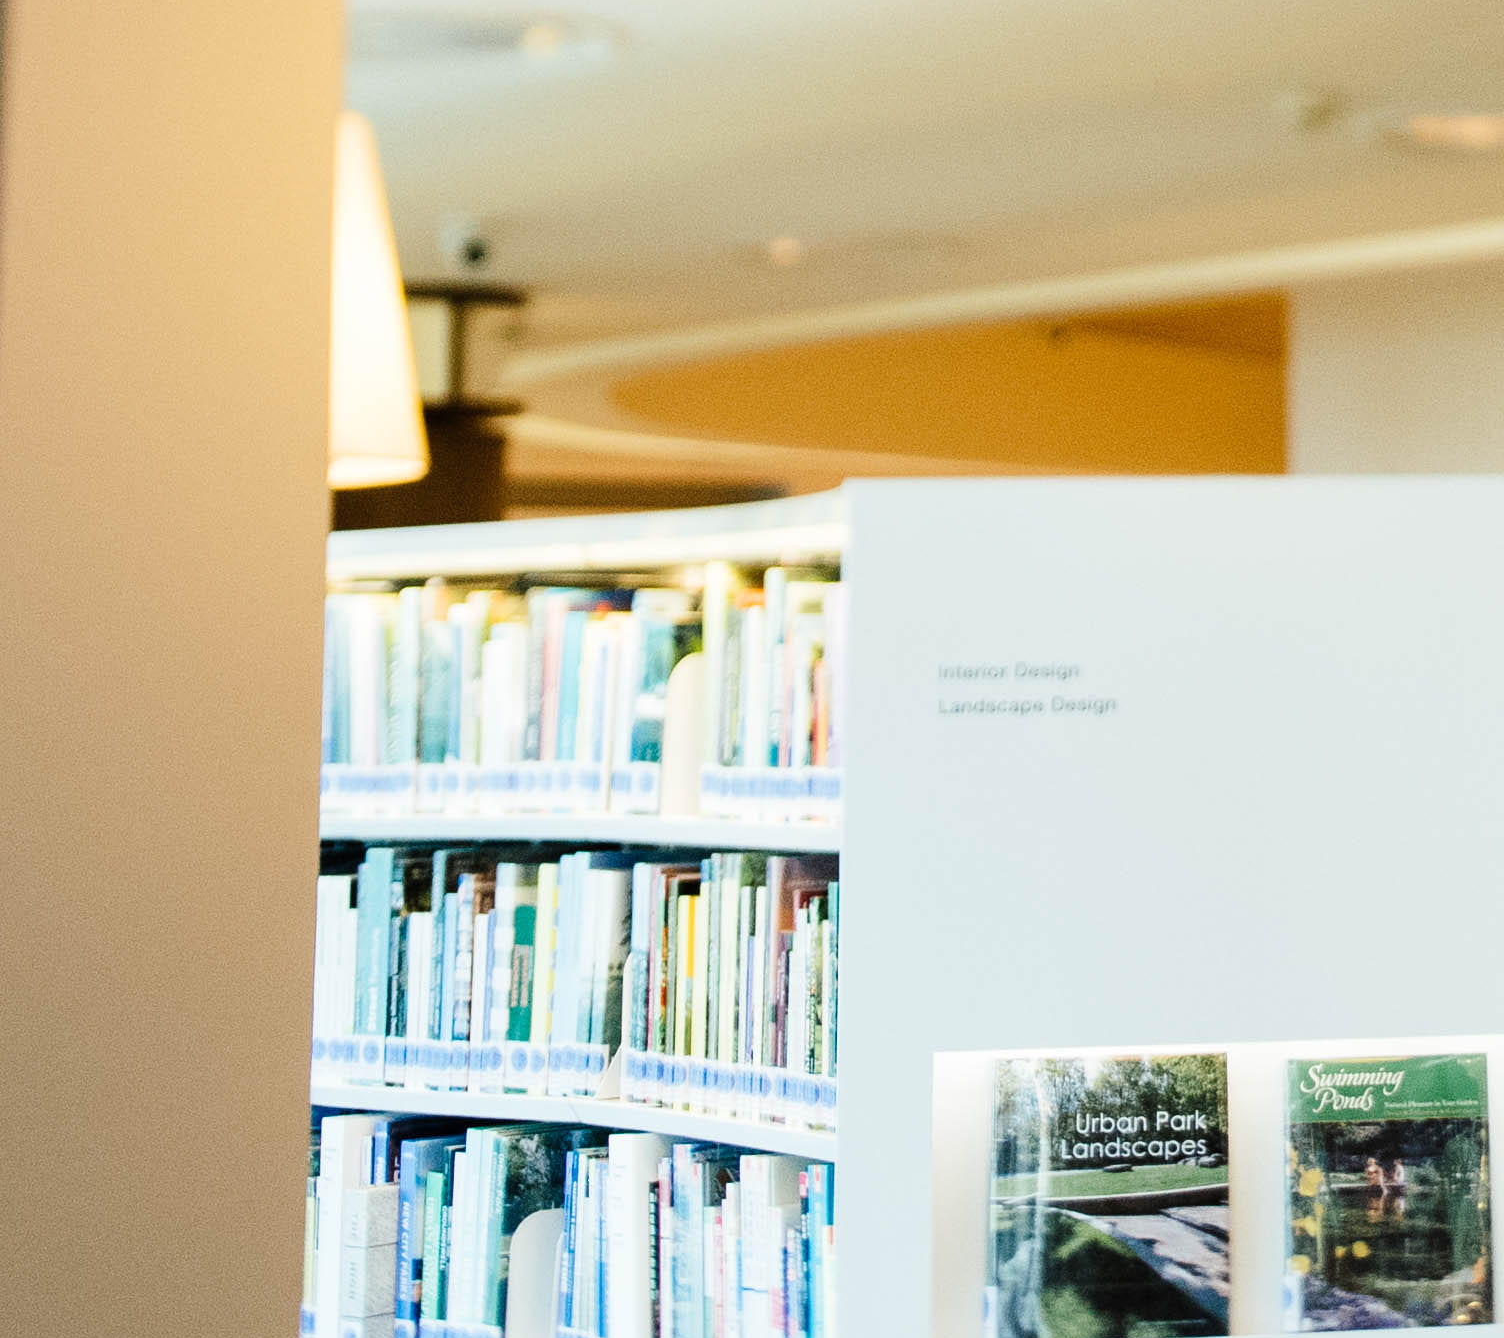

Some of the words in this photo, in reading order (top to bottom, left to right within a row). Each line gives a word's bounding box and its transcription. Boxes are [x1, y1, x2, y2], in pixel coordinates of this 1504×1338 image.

[938, 663, 1008, 679] Interior
[1014, 661, 1081, 681] Design
[938, 698, 1044, 716] Landscape
[1052, 695, 1118, 715] Design
[1299, 1063, 1406, 1096] Swimming
[1312, 1086, 1374, 1113] Ponds
[1076, 1112, 1147, 1135] Urban
[1156, 1109, 1207, 1132] Park
[1061, 1137, 1207, 1160] Landscapes
[402, 1201, 411, 1231] NEW
[400, 1231, 409, 1260] CITY
[399, 1261, 408, 1302] PARKS
